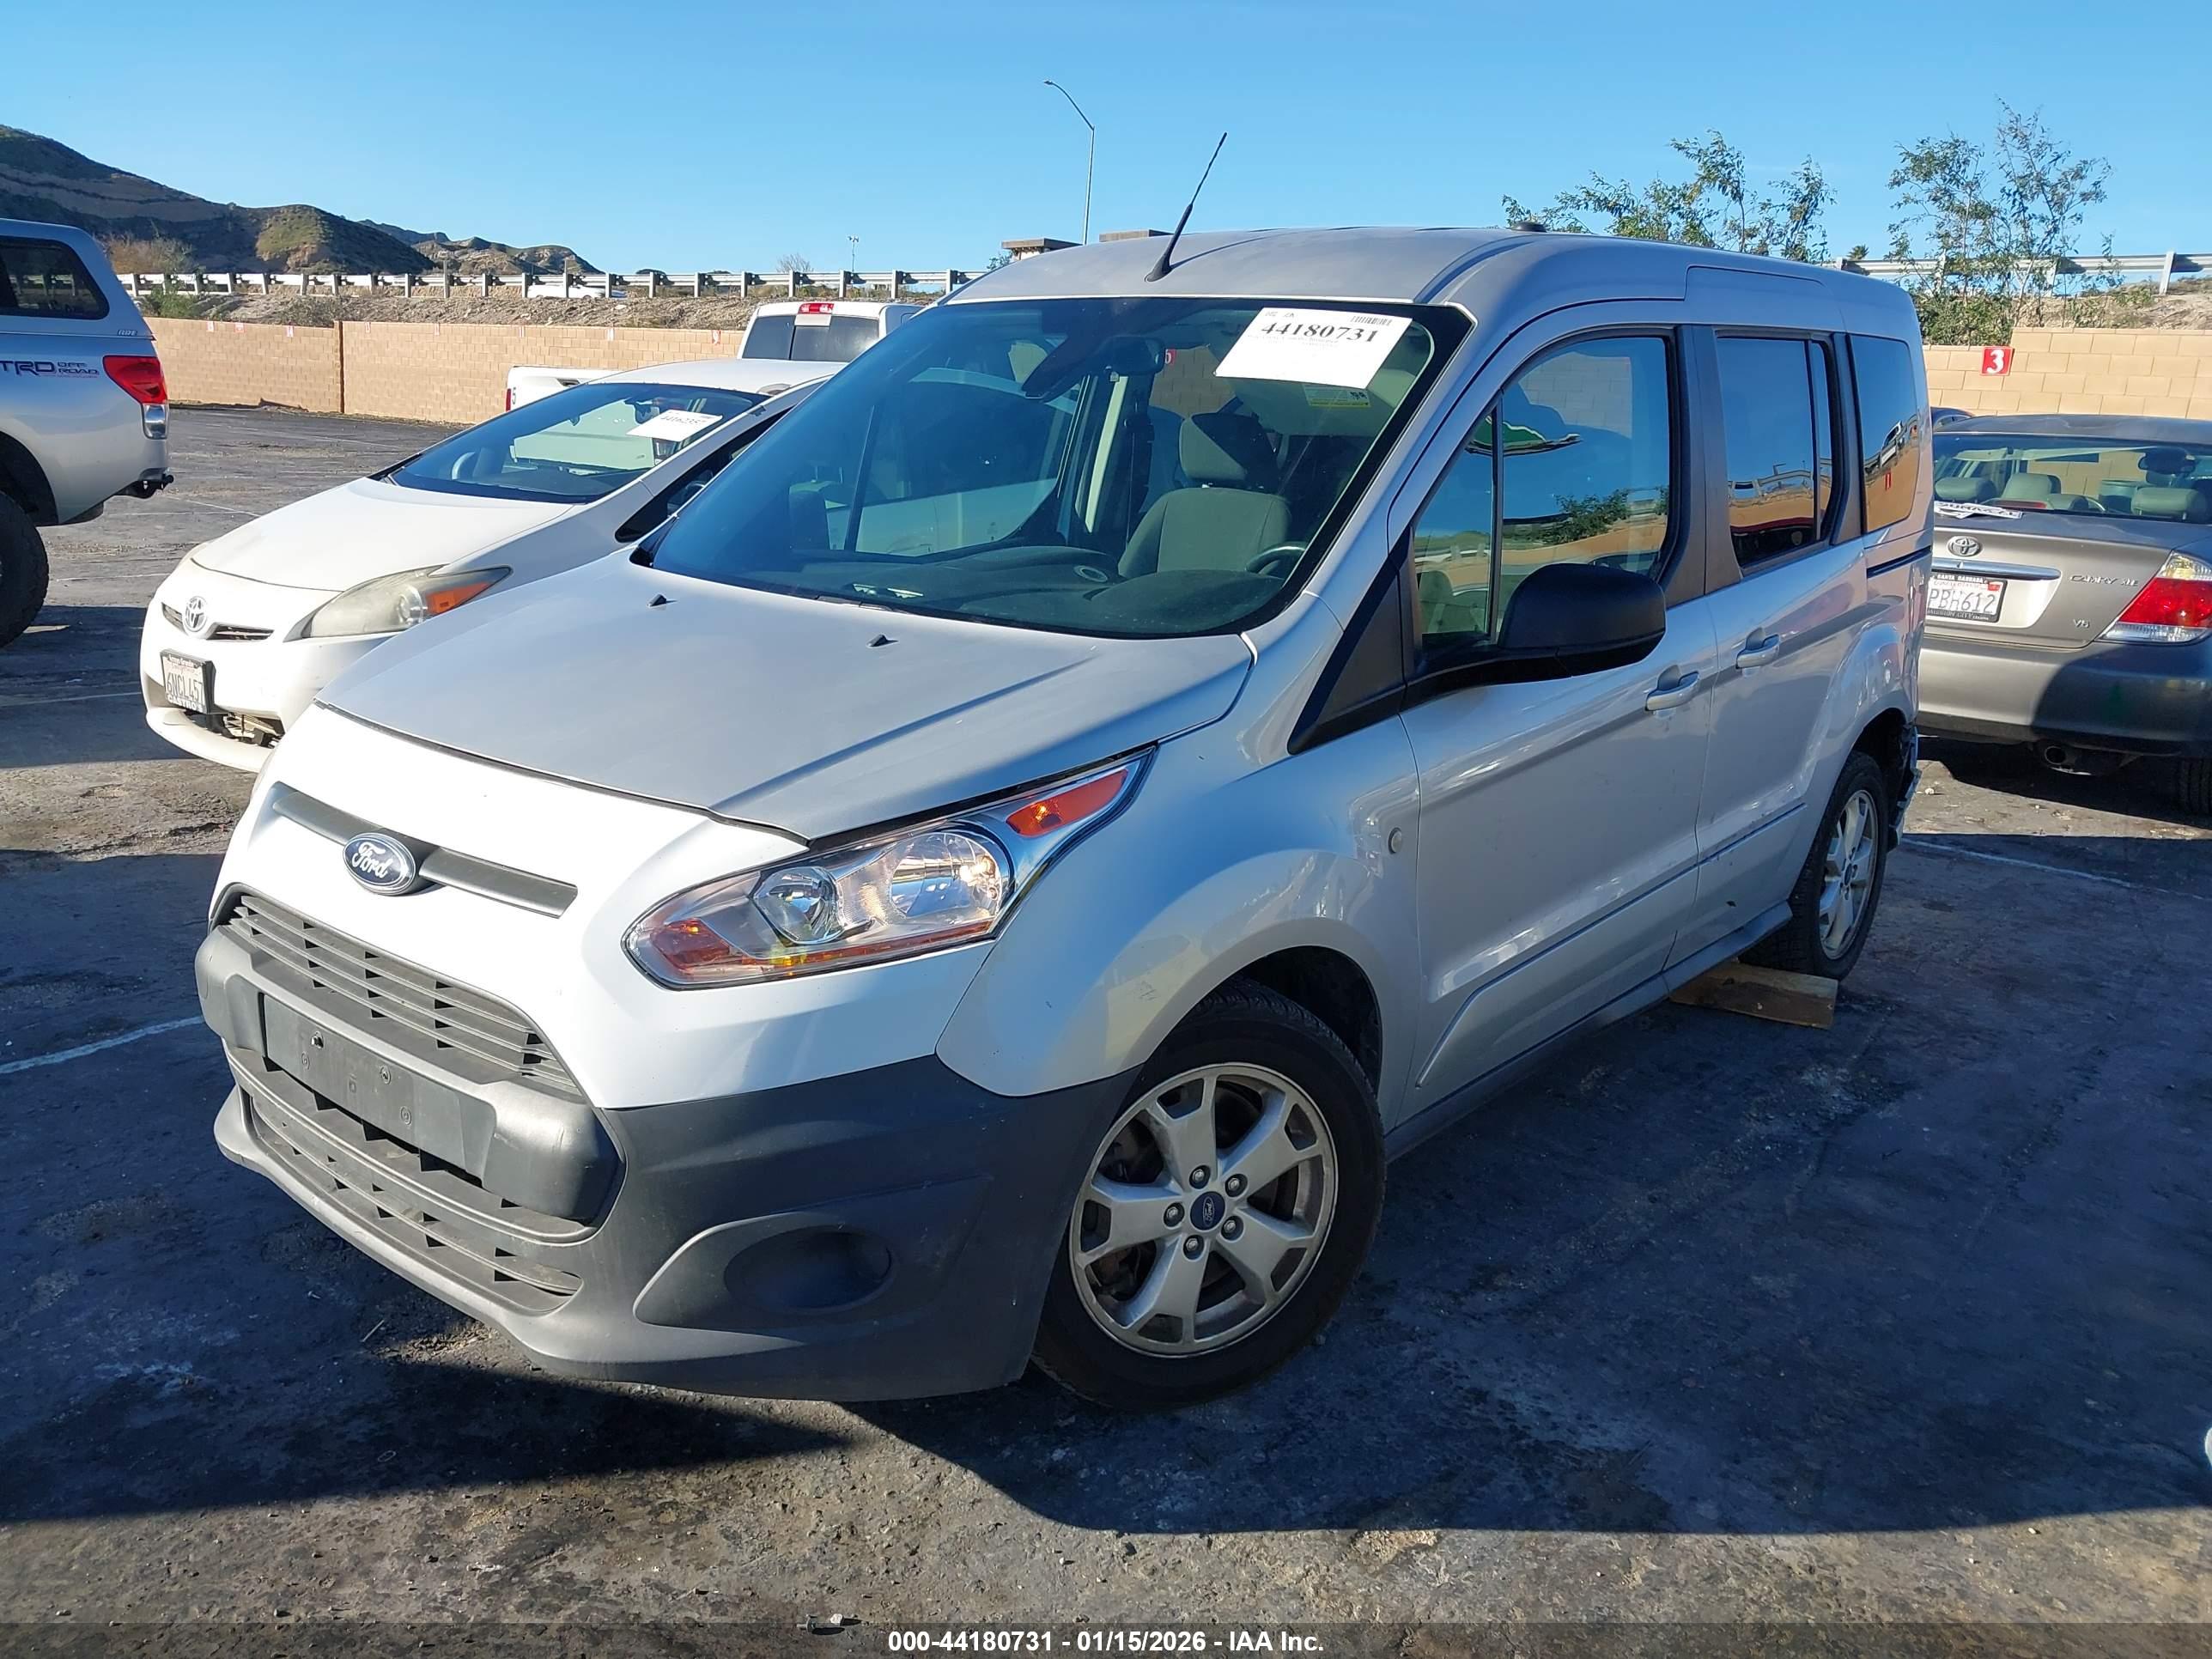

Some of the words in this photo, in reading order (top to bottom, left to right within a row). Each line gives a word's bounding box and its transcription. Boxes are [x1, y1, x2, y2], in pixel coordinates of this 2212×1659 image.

[1261, 322, 1377, 343] 44180731
[0, 361, 55, 376] TRD
[1986, 349, 2005, 374] 3
[2070, 574, 2118, 585] CAMRY
[167, 672, 204, 704] 6NCL457
[167, 694, 204, 714] CASTRO'S
[351, 842, 394, 879] Ford
